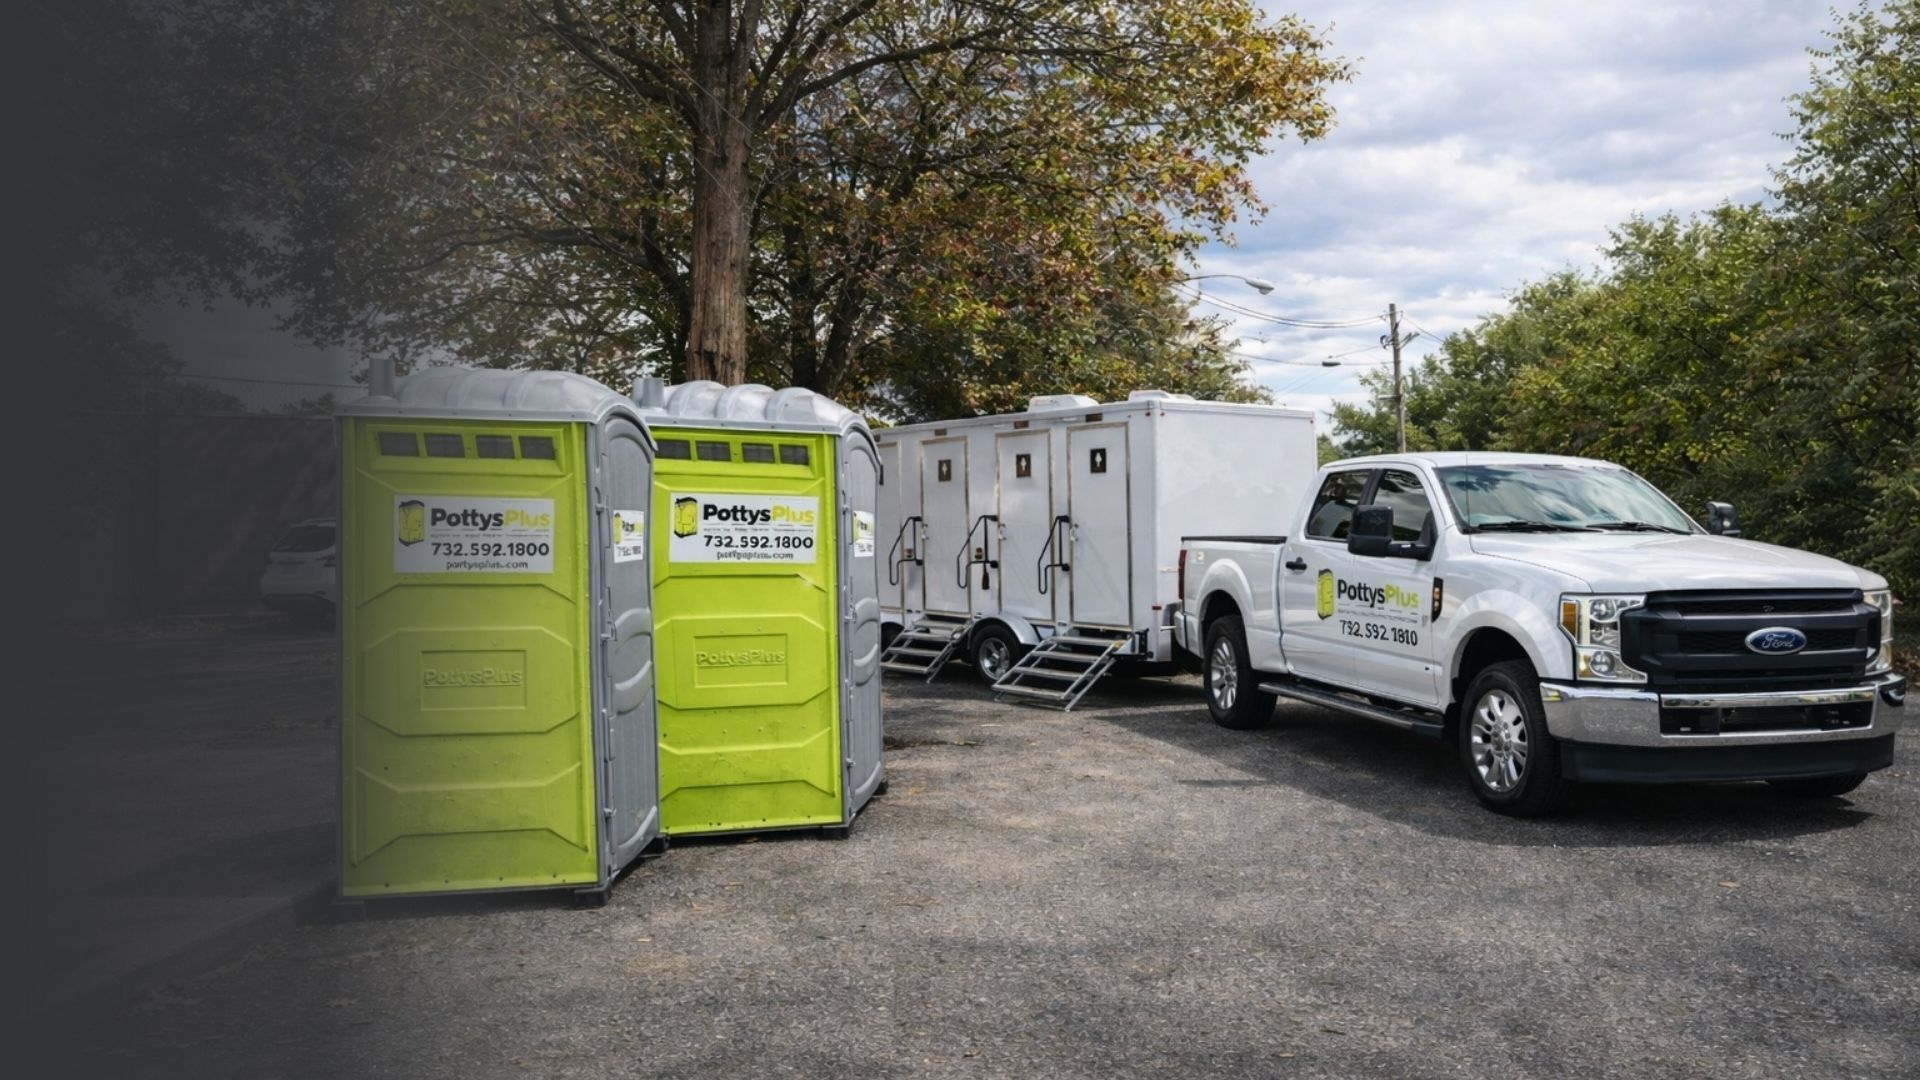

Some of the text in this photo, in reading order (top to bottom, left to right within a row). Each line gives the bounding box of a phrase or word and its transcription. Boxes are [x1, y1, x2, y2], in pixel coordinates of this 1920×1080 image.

[431, 508, 549, 531] PottysPlus
[703, 504, 814, 525] PottysPlus
[431, 542, 550, 557] 732.592.1800
[703, 535, 814, 549] 732.592.1800
[1338, 579, 1419, 608] PottysPlus
[1761, 633, 1795, 649] Ford
